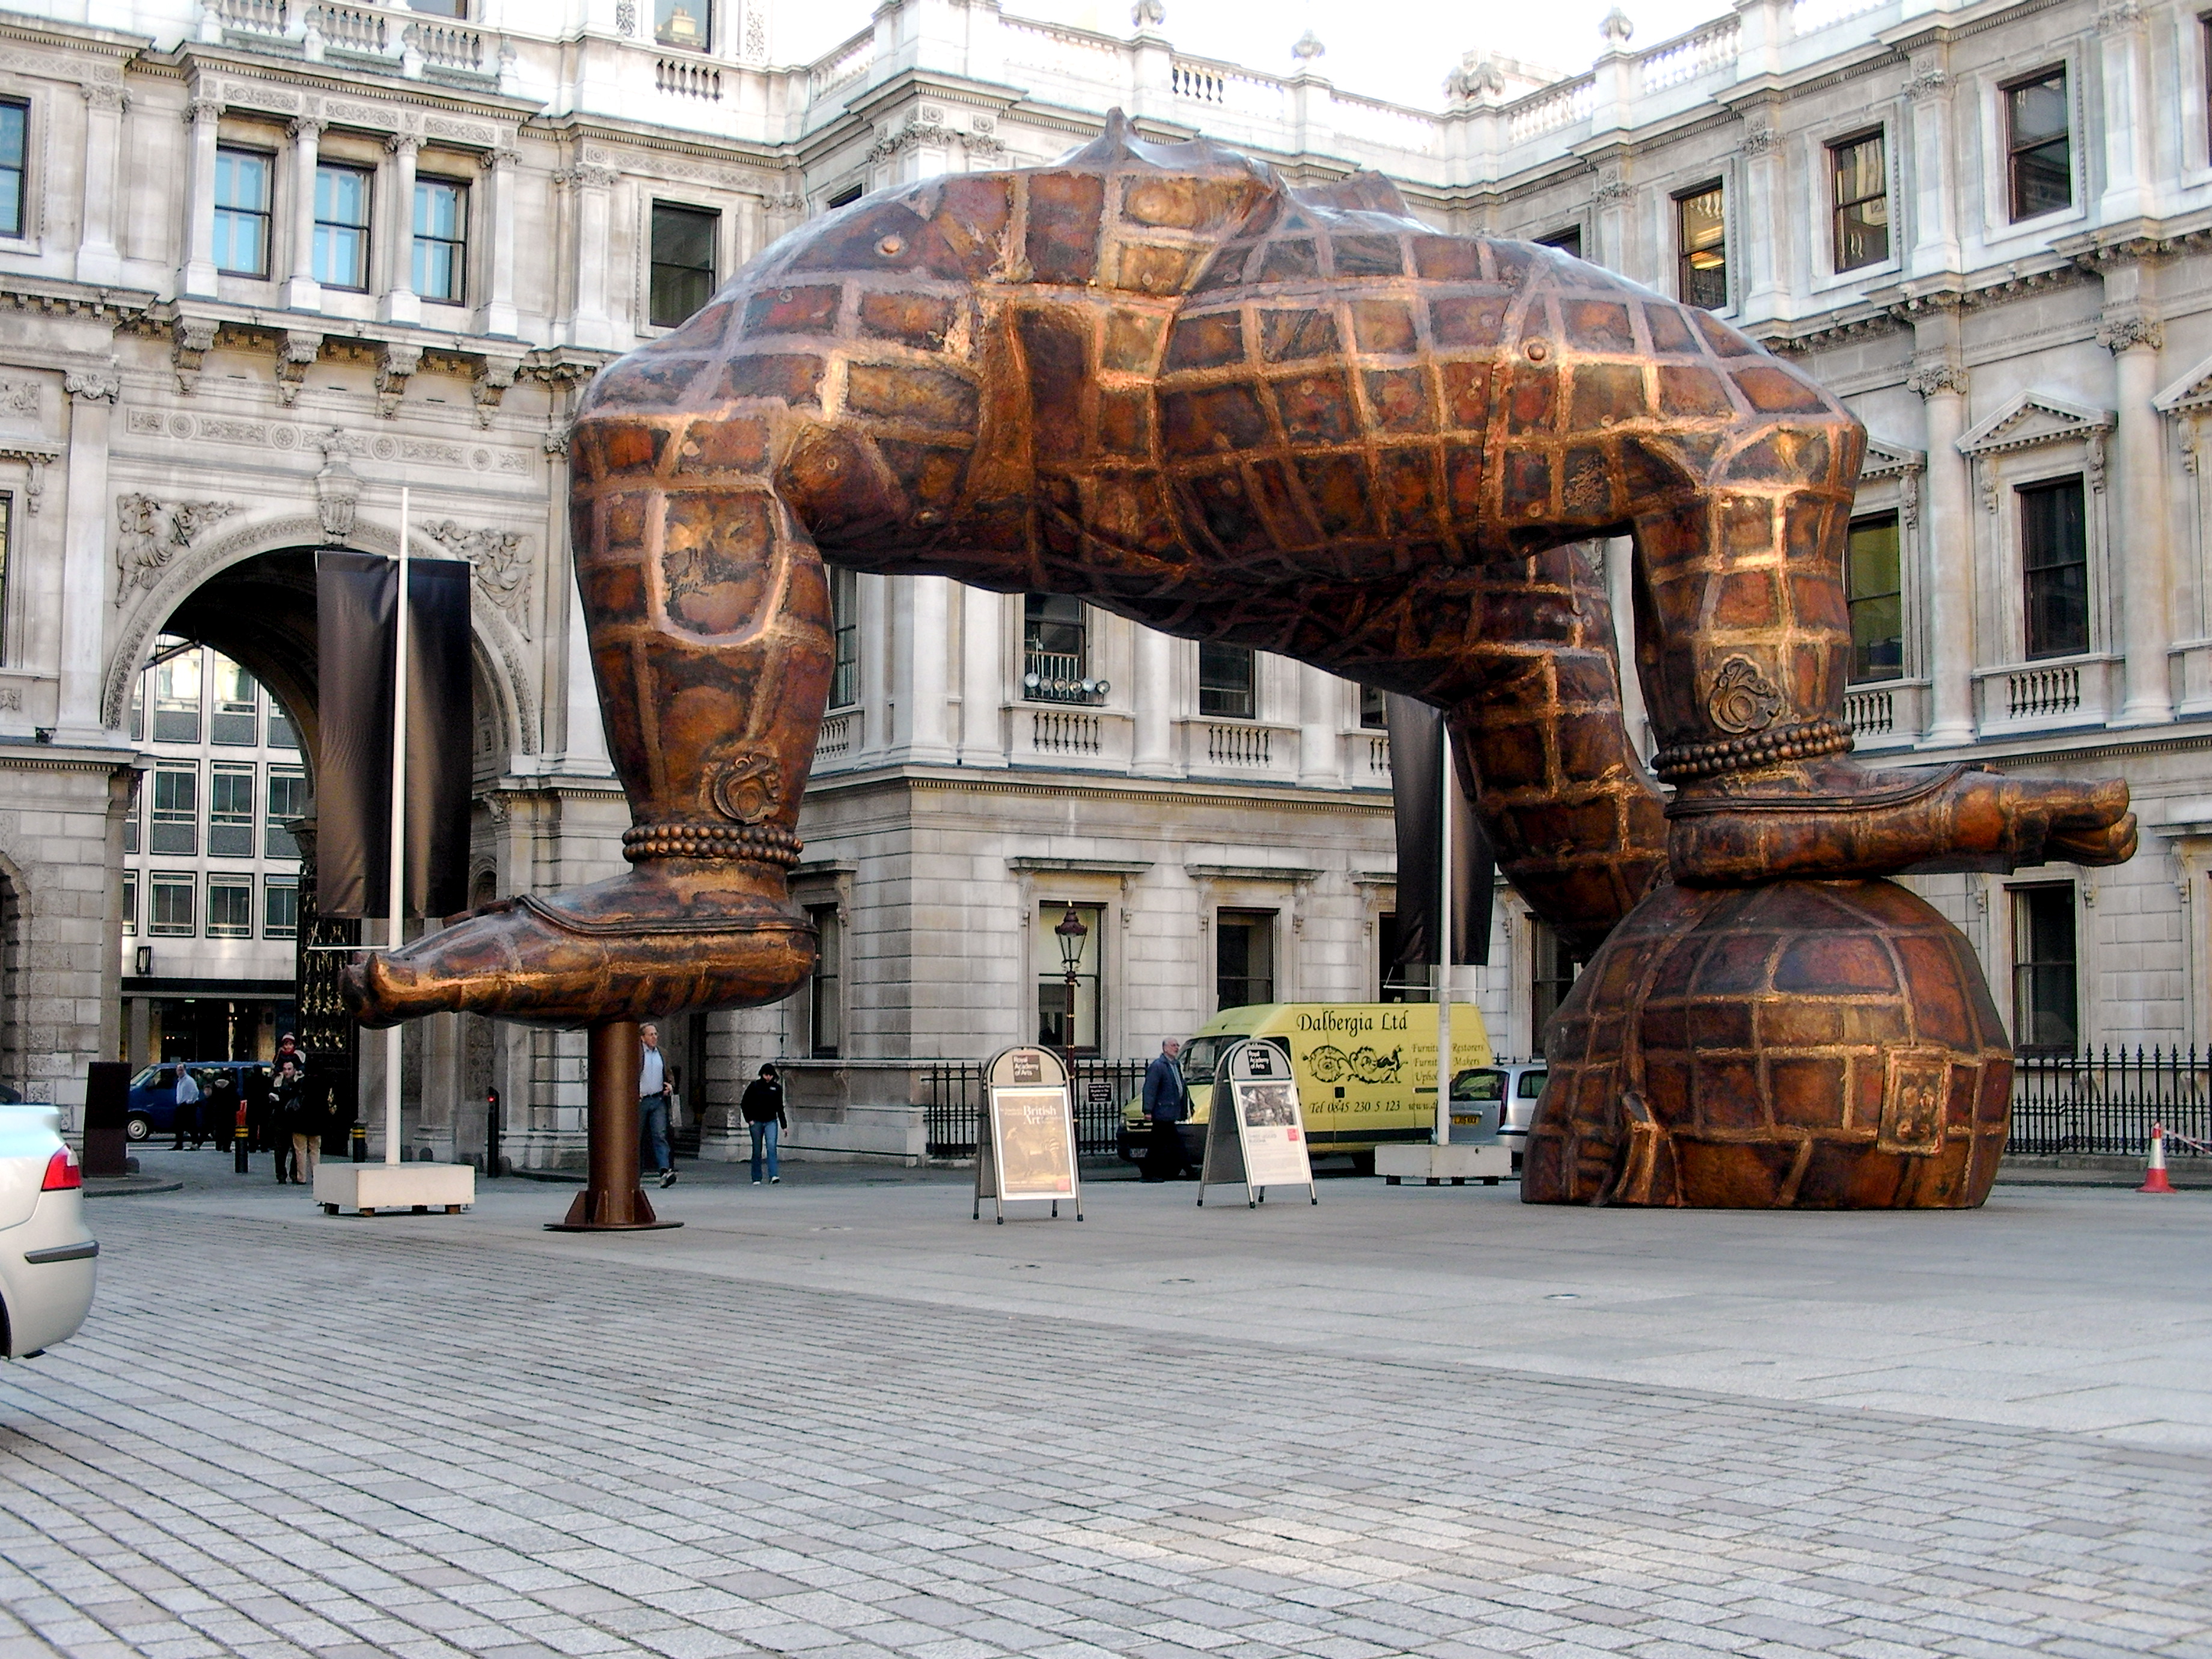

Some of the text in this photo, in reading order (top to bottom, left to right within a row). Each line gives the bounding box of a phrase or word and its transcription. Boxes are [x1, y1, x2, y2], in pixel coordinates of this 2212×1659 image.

[1297, 1010, 1409, 1037] Dalbergia Ltd
[1452, 1042, 1484, 1053] Restorers
[1414, 1056, 1480, 1067] Furnit Makers
[1023, 1105, 1056, 1116] British
[1309, 1100, 1401, 1113] Tel 0845 230 5 123
[1023, 1115, 1040, 1125] Art
